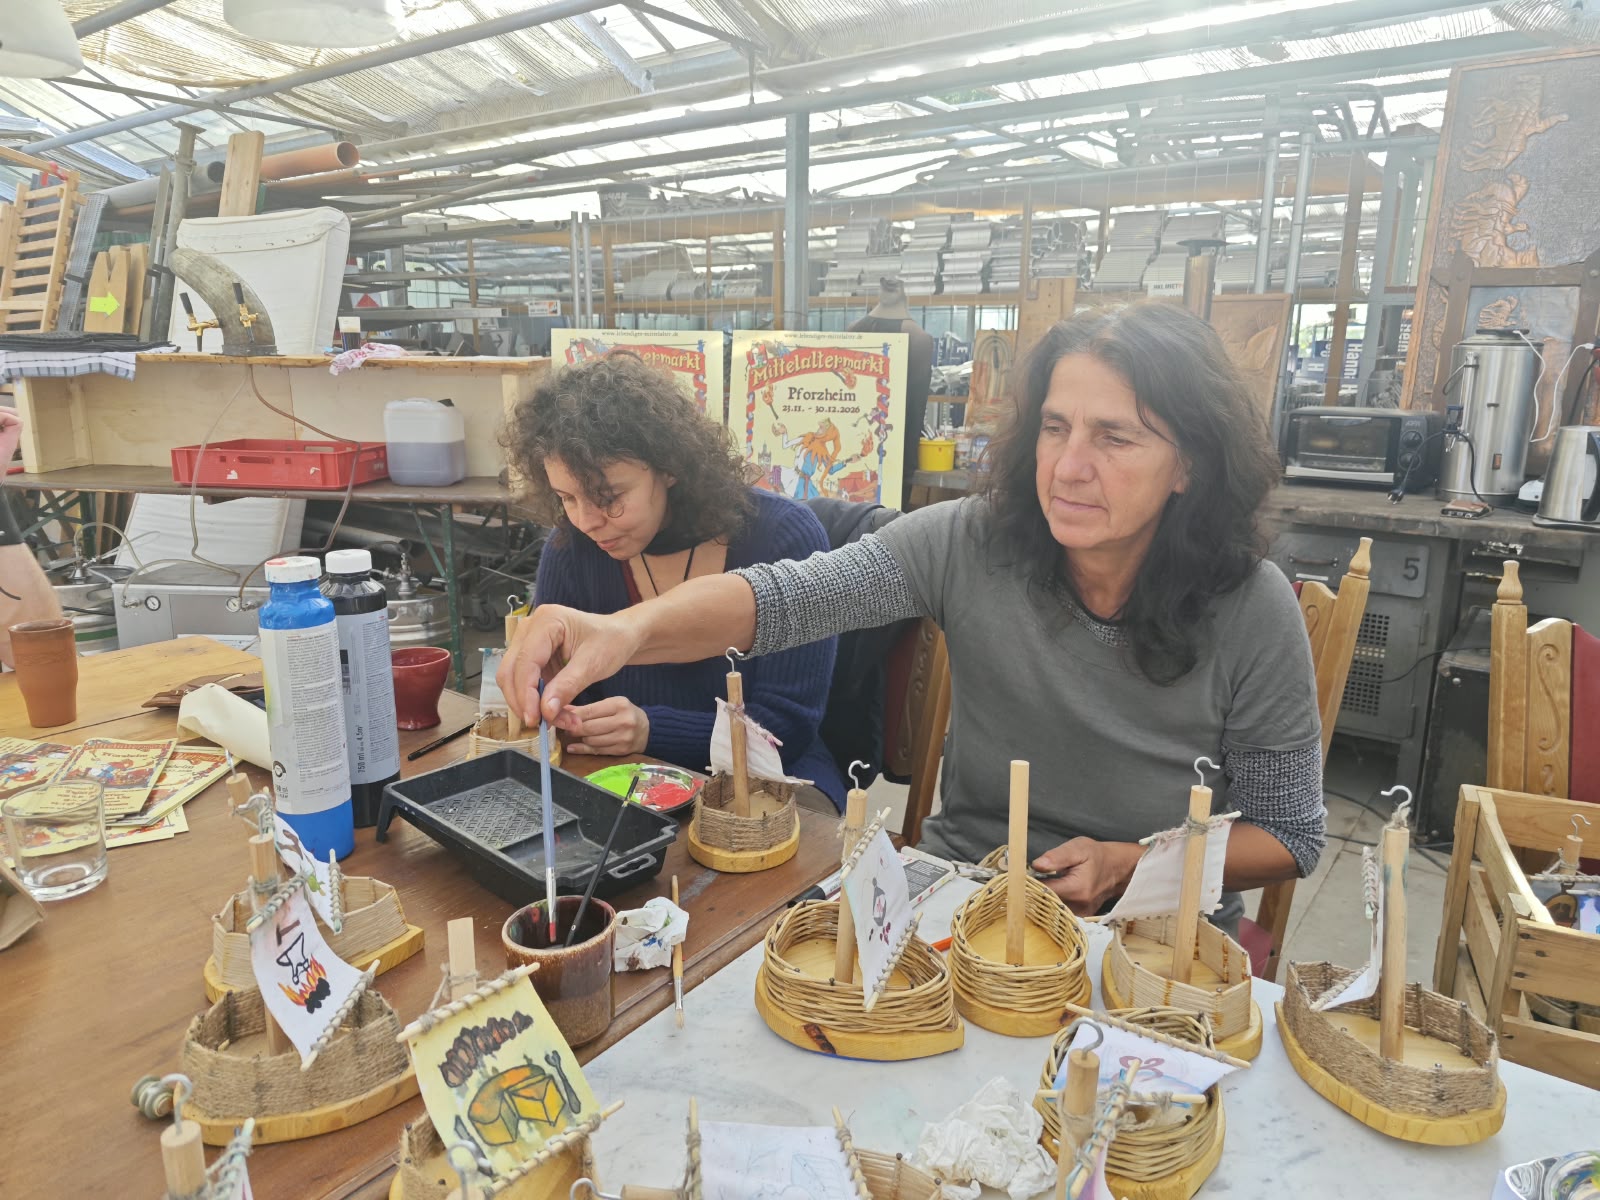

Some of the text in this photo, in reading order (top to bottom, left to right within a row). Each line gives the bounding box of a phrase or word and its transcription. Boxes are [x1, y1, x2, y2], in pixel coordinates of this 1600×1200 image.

[751, 351, 885, 387] Mittelaltermarkt
[788, 387, 857, 402] Pforzheim
[1403, 557, 1420, 581] 5
